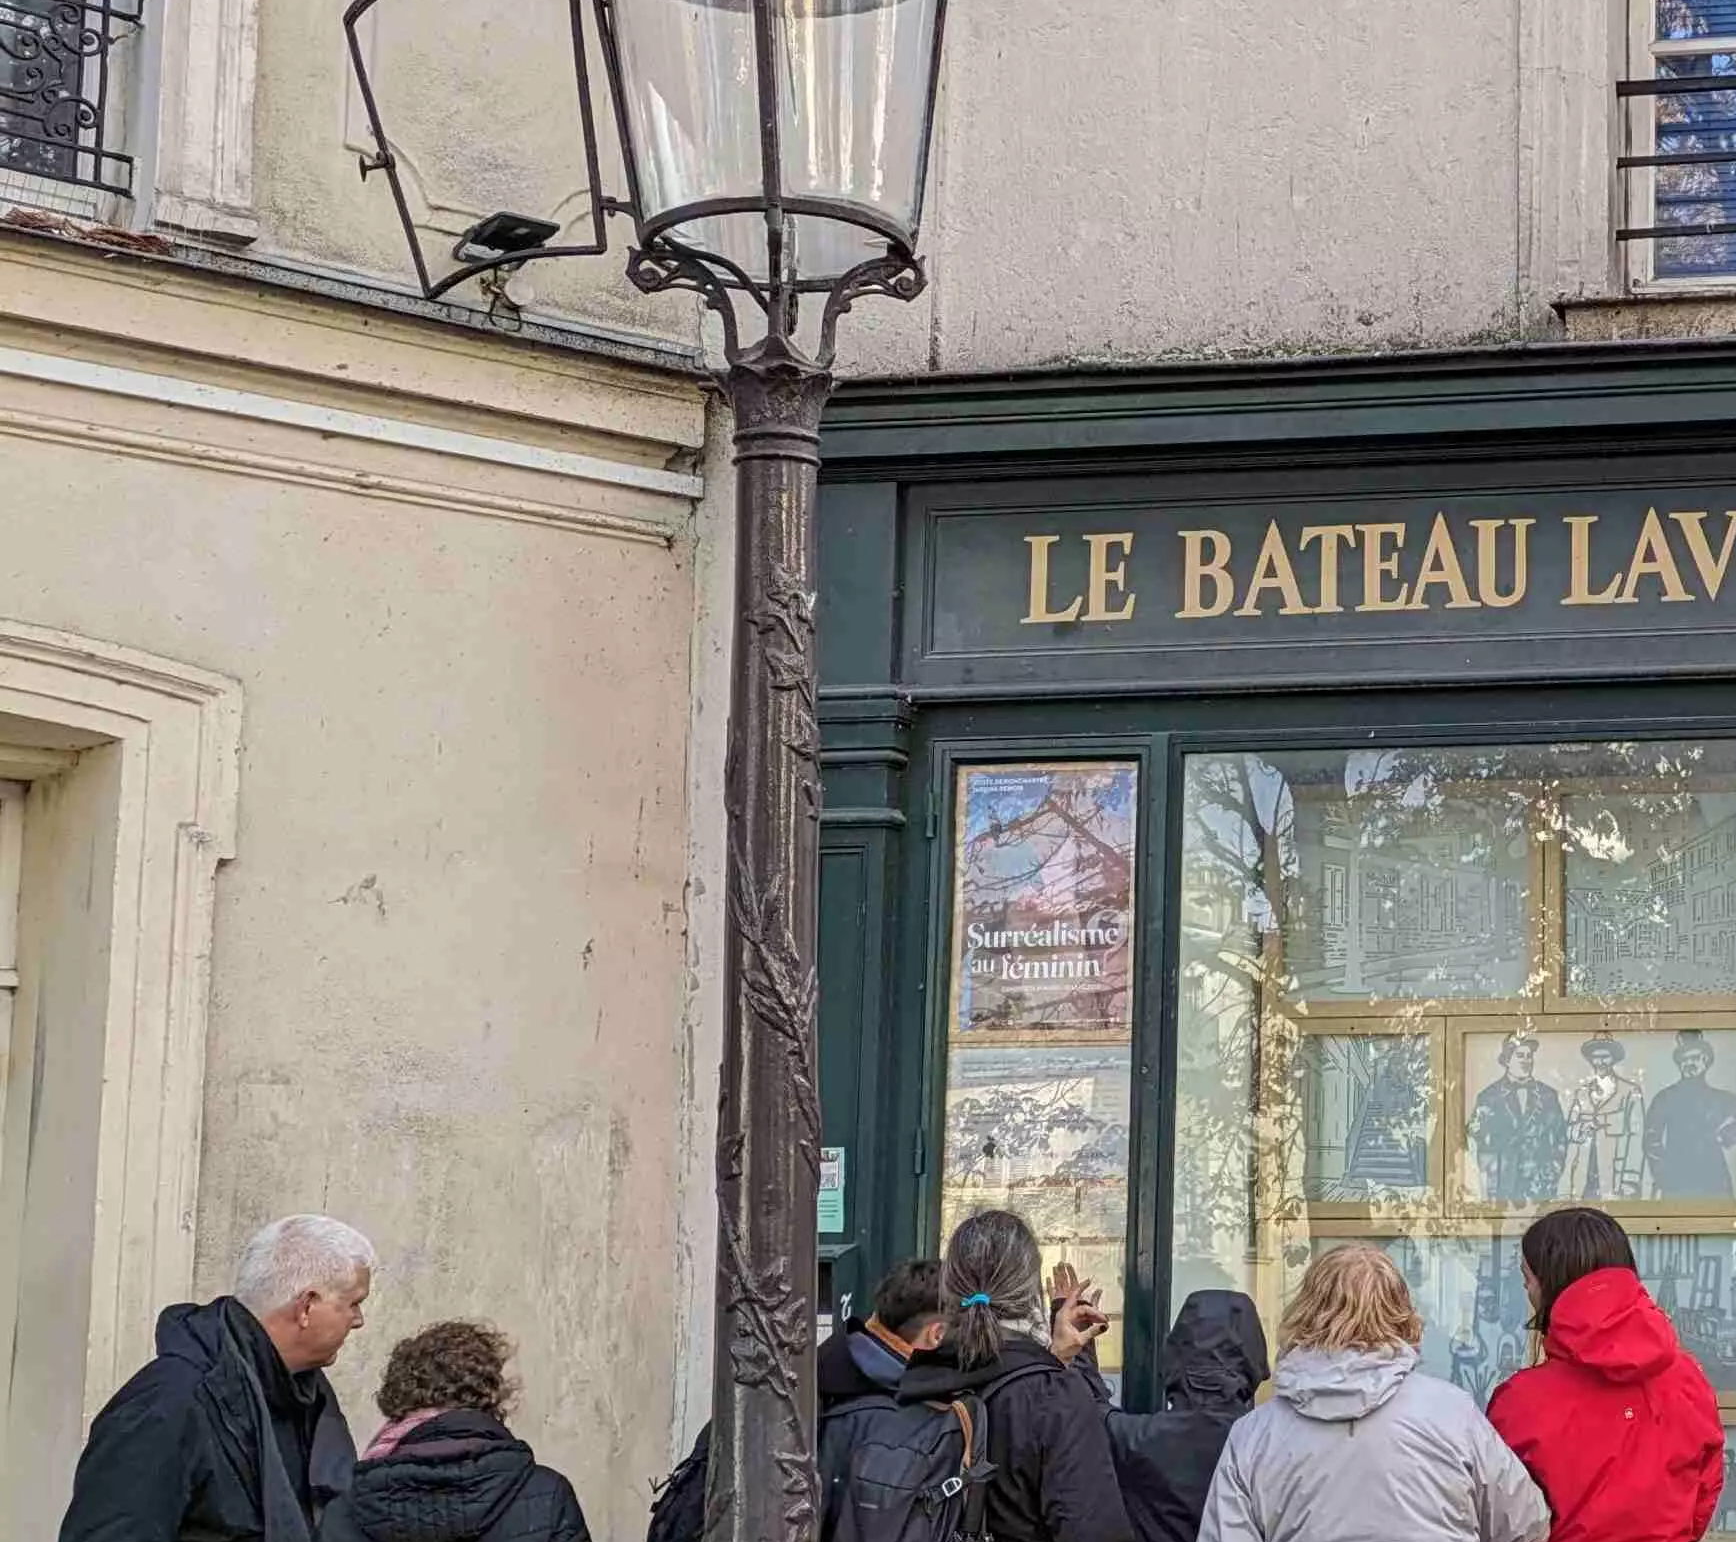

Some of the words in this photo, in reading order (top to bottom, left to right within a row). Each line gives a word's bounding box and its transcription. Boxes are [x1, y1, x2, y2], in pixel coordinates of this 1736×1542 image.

[1020, 531, 1137, 625] LE
[1174, 510, 1537, 618] BATEAU
[967, 919, 1120, 949] Surréalisme
[971, 958, 994, 974] au
[1001, 952, 1101, 980] féminin
